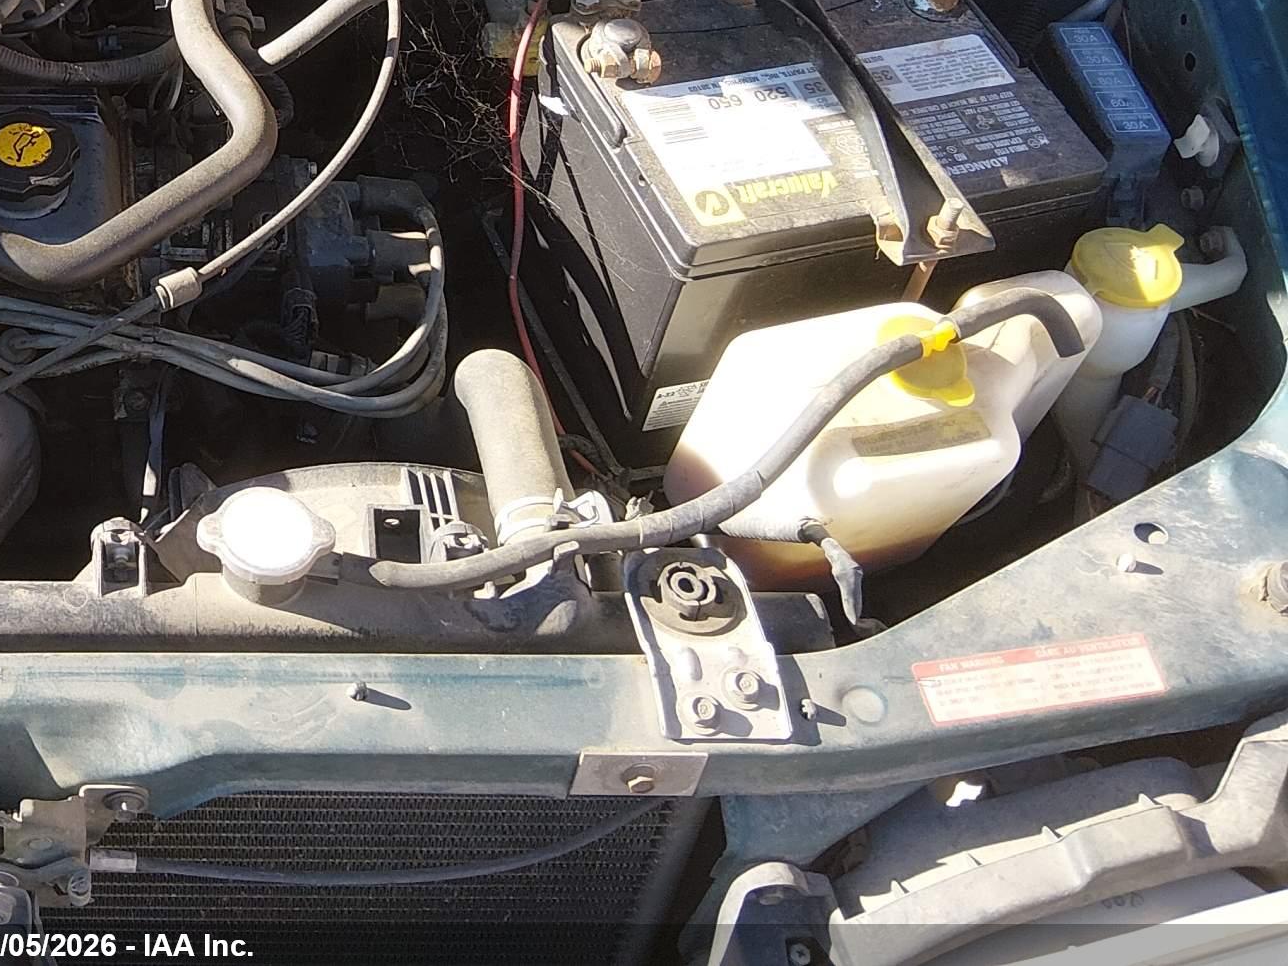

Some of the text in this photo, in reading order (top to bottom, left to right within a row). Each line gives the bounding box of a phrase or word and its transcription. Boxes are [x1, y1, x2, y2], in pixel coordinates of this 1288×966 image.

[706, 80, 826, 109] 35 520 650
[940, 663, 958, 672] FAN
